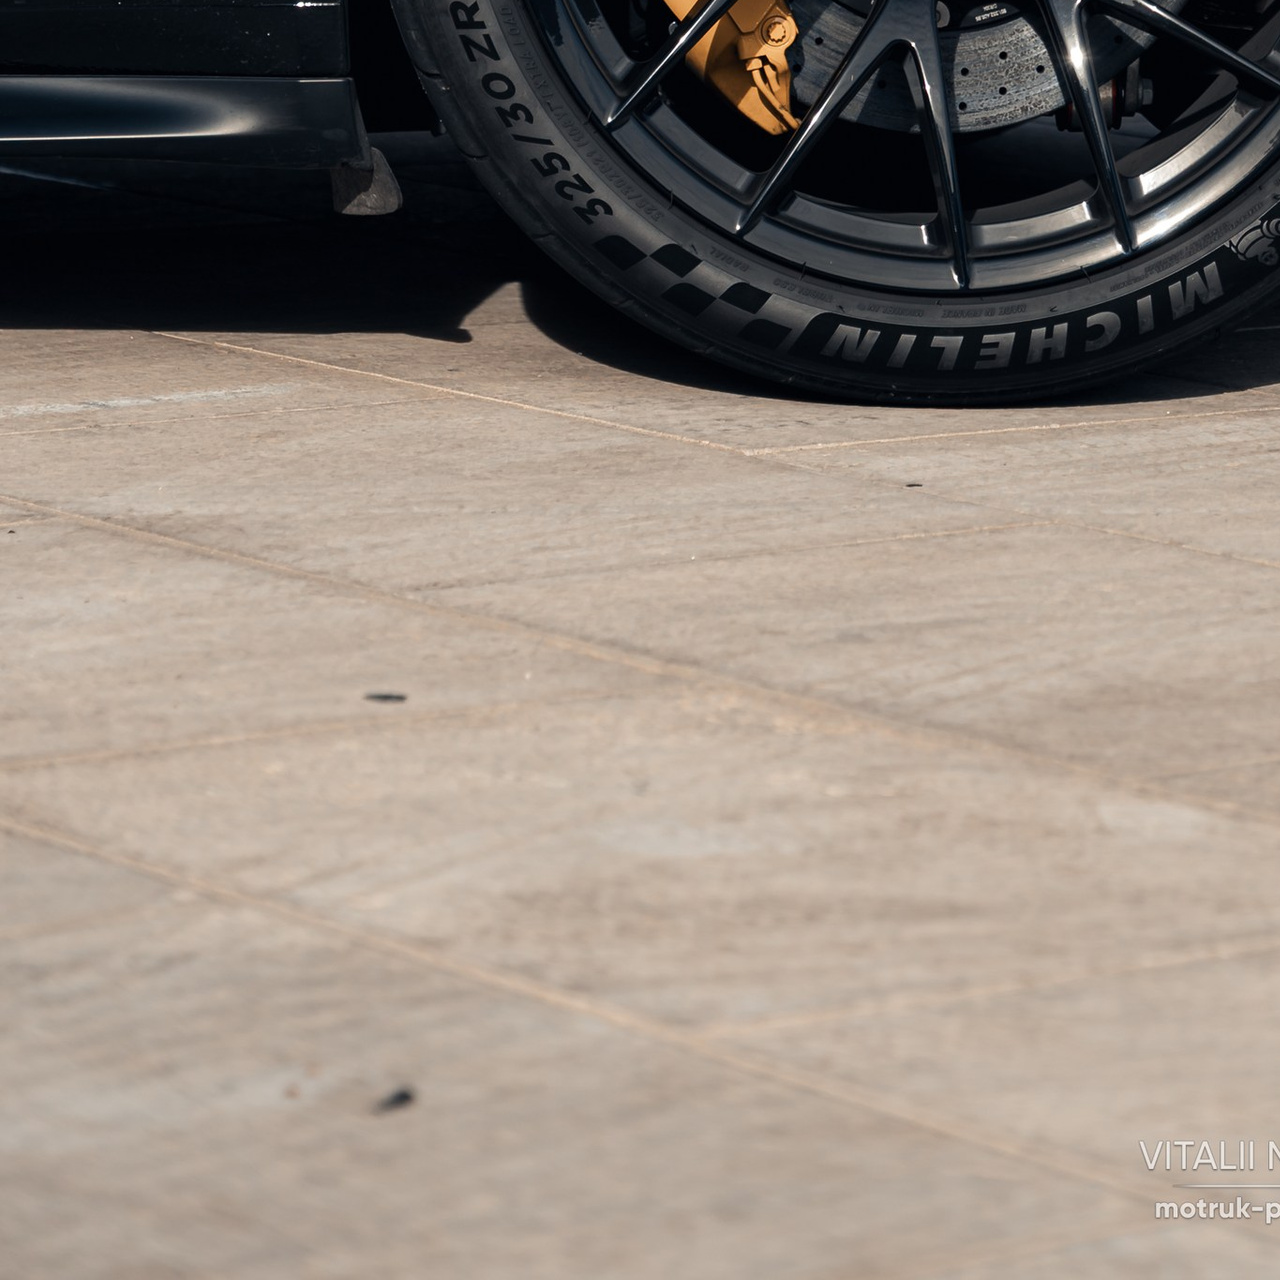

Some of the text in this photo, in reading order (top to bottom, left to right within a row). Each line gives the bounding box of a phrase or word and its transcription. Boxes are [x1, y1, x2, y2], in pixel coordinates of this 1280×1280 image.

[450, 0, 500, 62] ZR
[480, 71, 614, 226] 325/30
[706, 245, 750, 274] RADIAL
[820, 260, 1224, 370] MICHELIN
